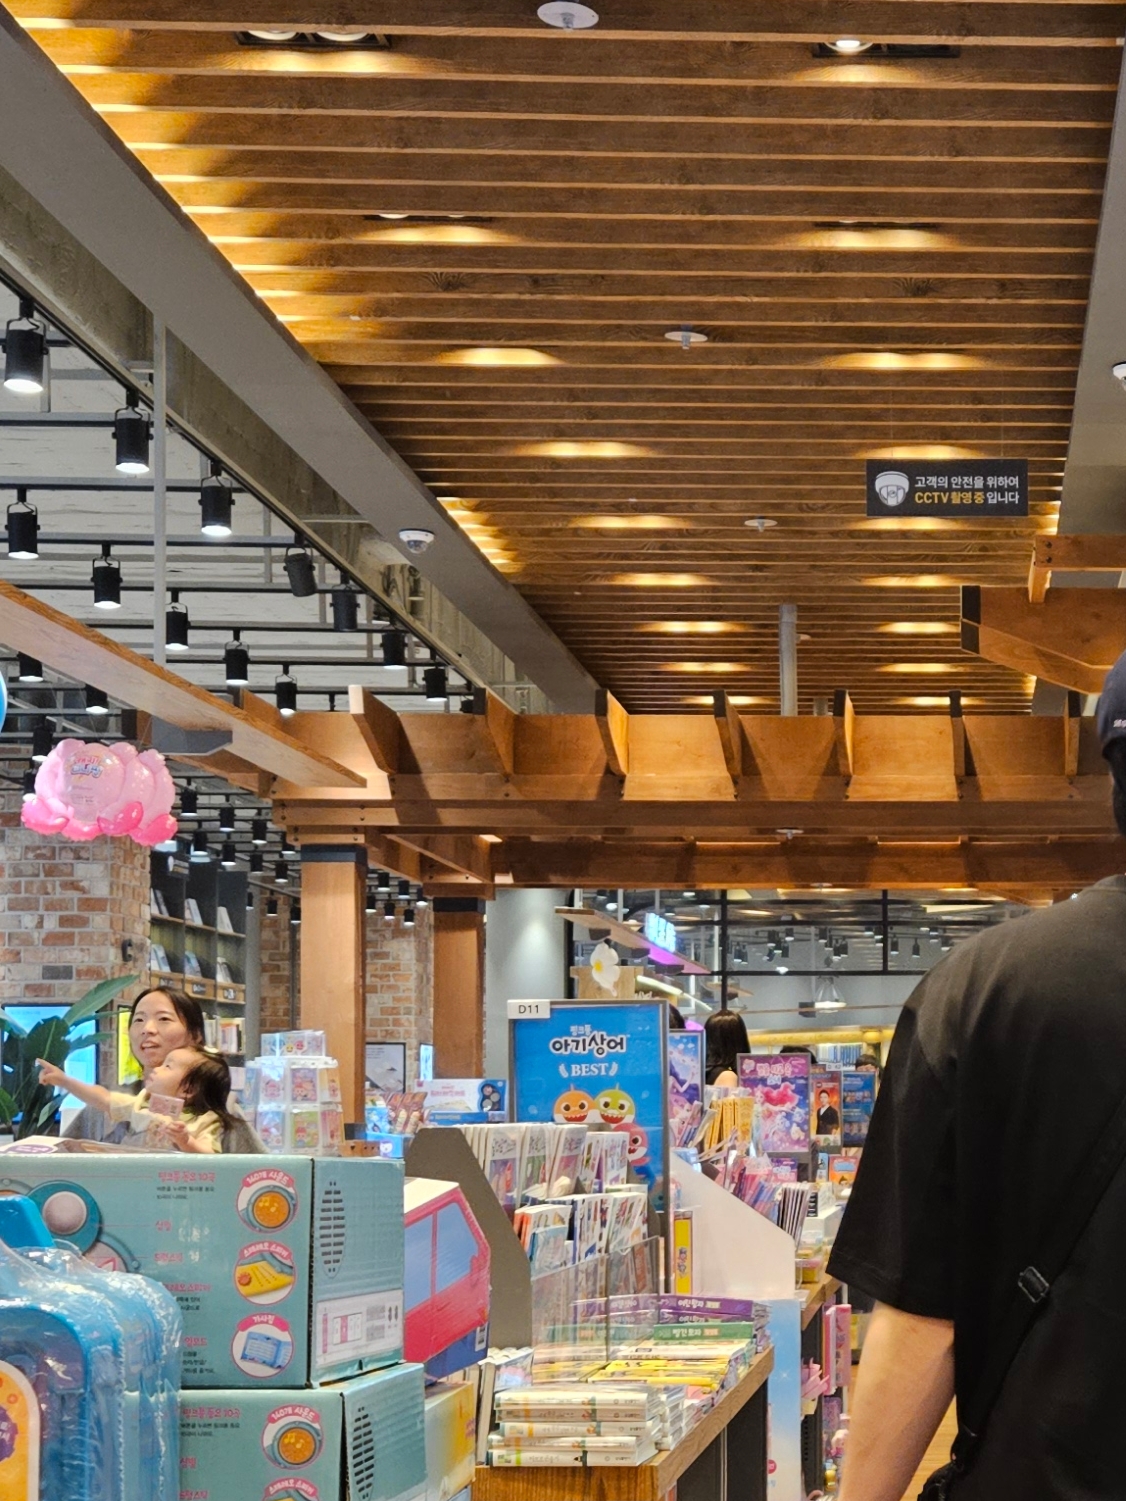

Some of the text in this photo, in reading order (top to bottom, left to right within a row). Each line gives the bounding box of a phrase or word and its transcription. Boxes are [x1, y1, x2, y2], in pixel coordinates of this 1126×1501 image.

[914, 475, 1019, 489] 고객의 안전을 위하여
[914, 491, 1020, 505] CCTV 촬영 중 입니다
[518, 1004, 539, 1014] D11
[551, 1031, 625, 1056] 아기상어
[571, 1063, 609, 1076] BEST
[294, 1406, 316, 1420] 사운드
